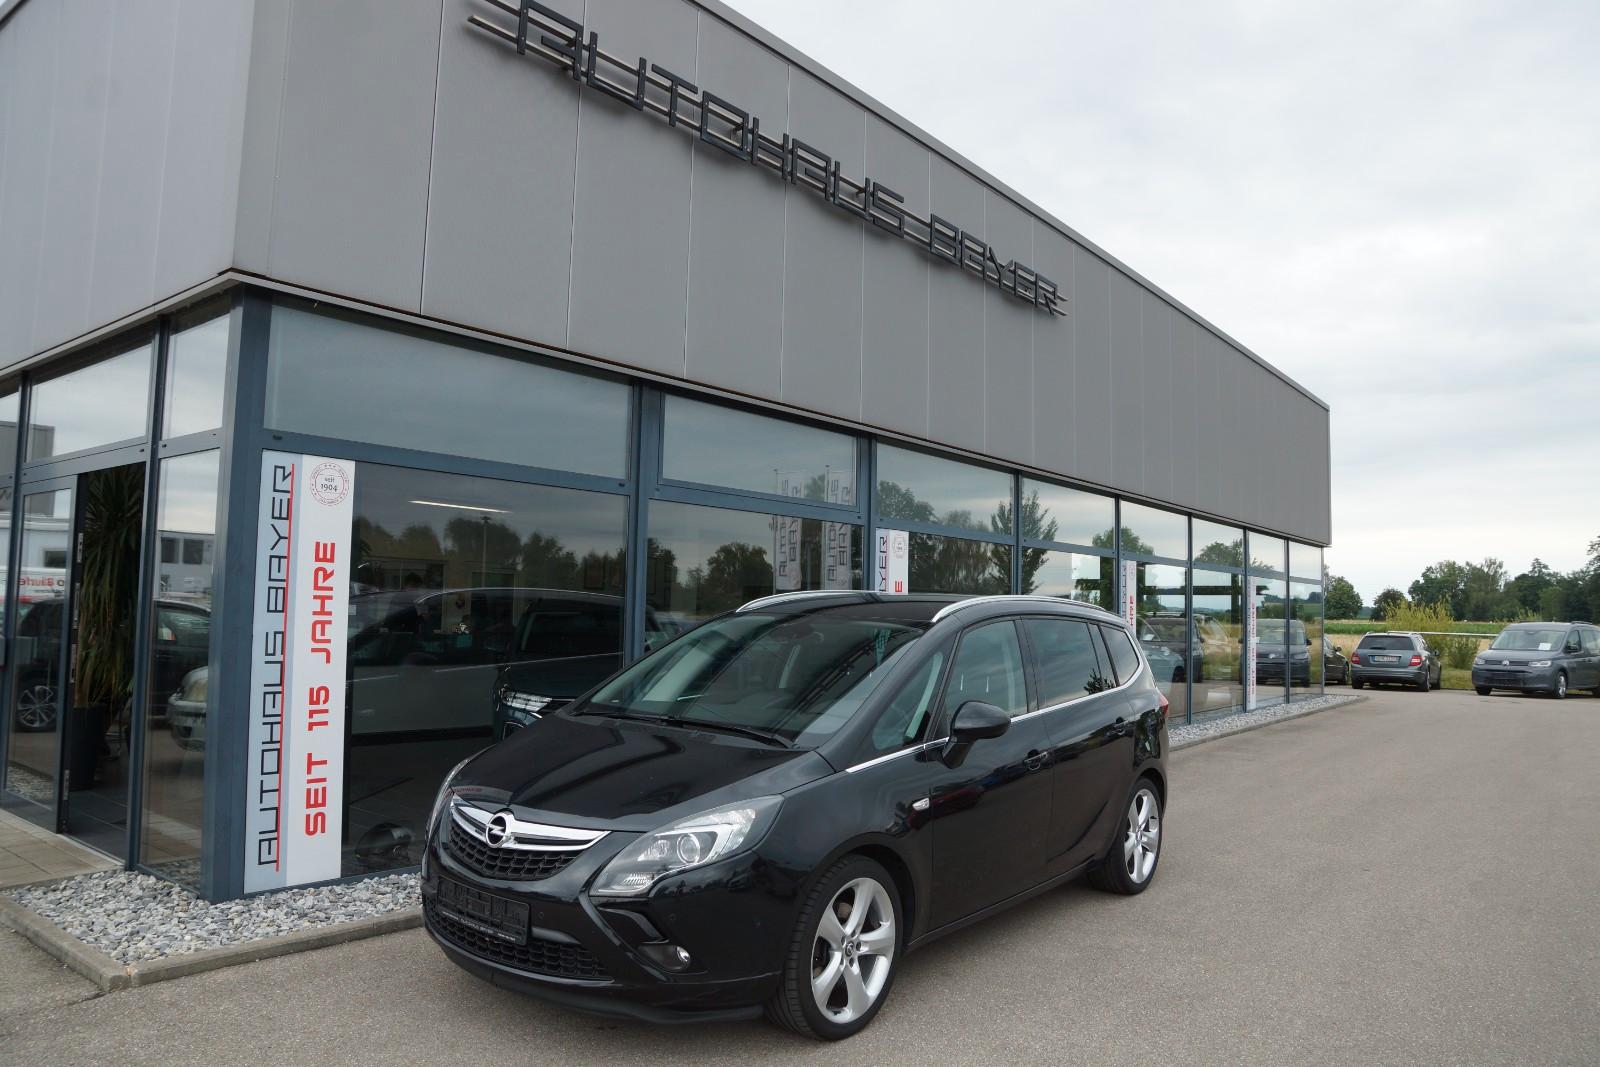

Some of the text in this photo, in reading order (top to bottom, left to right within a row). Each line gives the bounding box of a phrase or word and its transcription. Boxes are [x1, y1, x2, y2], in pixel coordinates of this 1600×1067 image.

[517, 0, 1057, 315] AUTOHAUS BAYER
[320, 484, 338, 492] 1904
[879, 536, 888, 593] YER
[258, 465, 292, 865] AUTOHAUS BAYER
[305, 541, 336, 836] SEIT 115 JAHRE
